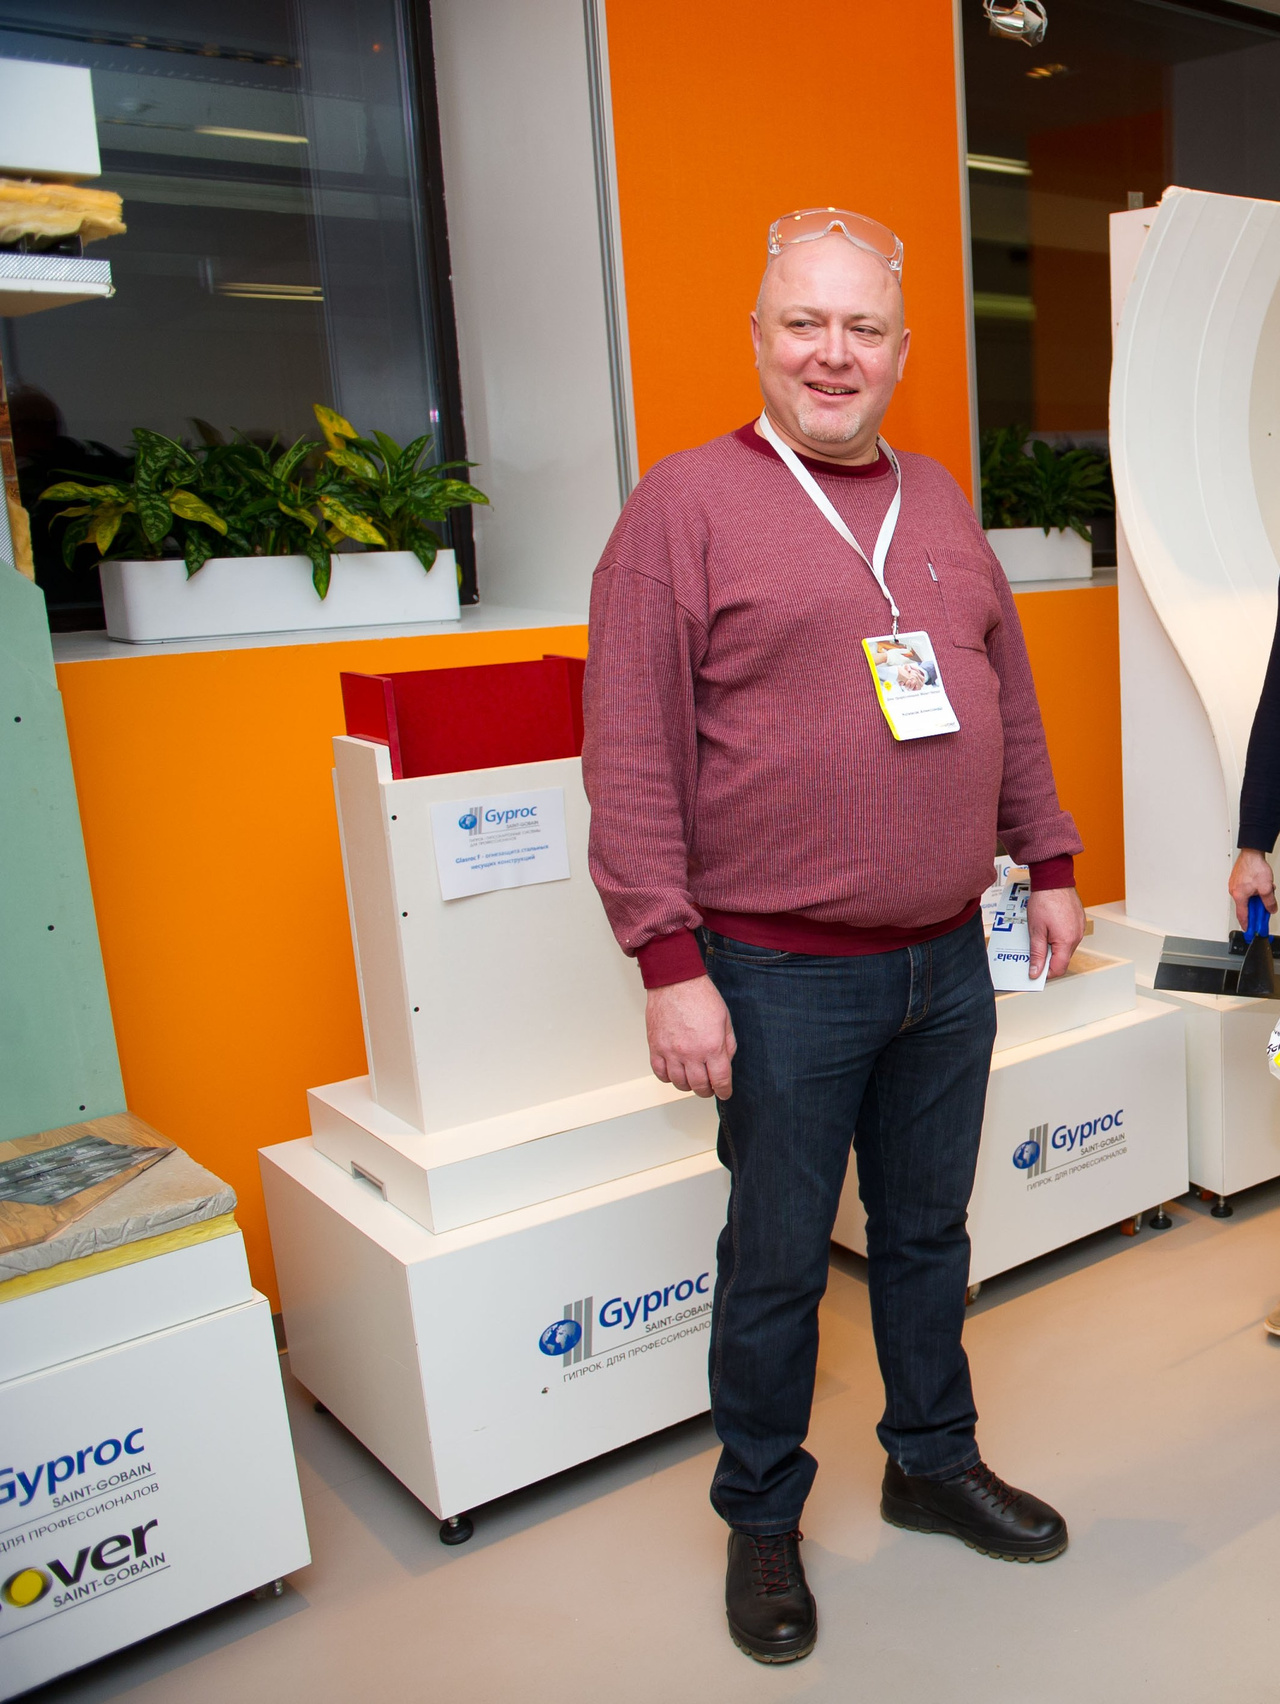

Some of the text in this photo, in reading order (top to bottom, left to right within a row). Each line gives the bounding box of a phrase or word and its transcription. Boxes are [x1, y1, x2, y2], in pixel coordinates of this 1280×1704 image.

[485, 806, 537, 825] Gyproc
[1051, 1109, 1124, 1152] Gyproc
[1080, 1132, 1125, 1156] SAINT-GOBAIN
[598, 1272, 710, 1330] Gyproc
[645, 1301, 713, 1333] SAINT-GOBAIN
[606, 1352, 626, 1368] ДЛЯ
[628, 1320, 711, 1358] ПРОФЕССИОНАЛО
[0, 1427, 145, 1507] Gyproc
[52, 1462, 152, 1508] SAINT-GOBAIN
[29, 1482, 160, 1542] ПРОФЕССИОНАЛОВ
[0, 1518, 159, 1611] over
[53, 1552, 166, 1608] SAINT-GOBAIN
